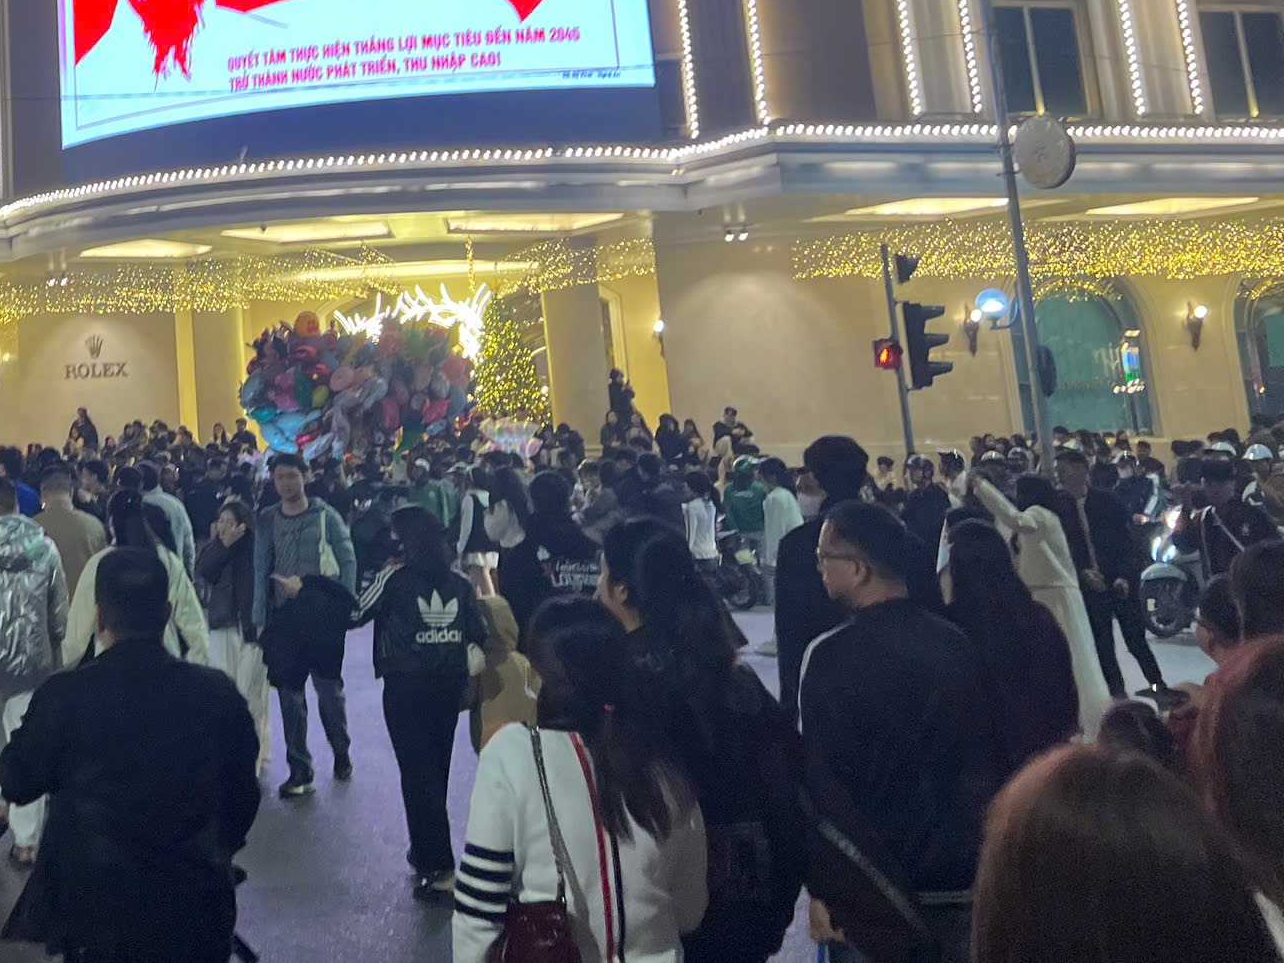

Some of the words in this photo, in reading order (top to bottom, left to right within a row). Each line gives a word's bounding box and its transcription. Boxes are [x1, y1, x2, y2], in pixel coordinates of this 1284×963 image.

[227, 49, 259, 73] QUYẾT
[263, 47, 286, 66] TÂM
[289, 45, 319, 64] THỰC
[323, 40, 350, 61] HIỆN
[354, 35, 394, 55] THẮNG
[399, 34, 416, 53] LỢI
[422, 33, 451, 51] MỤC
[454, 28, 482, 47] TIÊU
[485, 25, 511, 46] ĐẾN
[515, 26, 546, 44] NĂM
[549, 26, 581, 43] 2045
[229, 70, 249, 93] TRỞ
[252, 69, 288, 88] THÀNH
[291, 63, 323, 83] NƯỚC
[326, 60, 357, 80] PHÁT
[403, 56, 427, 74] THU
[431, 51, 466, 76] NHẬP
[470, 51, 501, 69] CAO!
[64, 362, 129, 379] ROLEX
